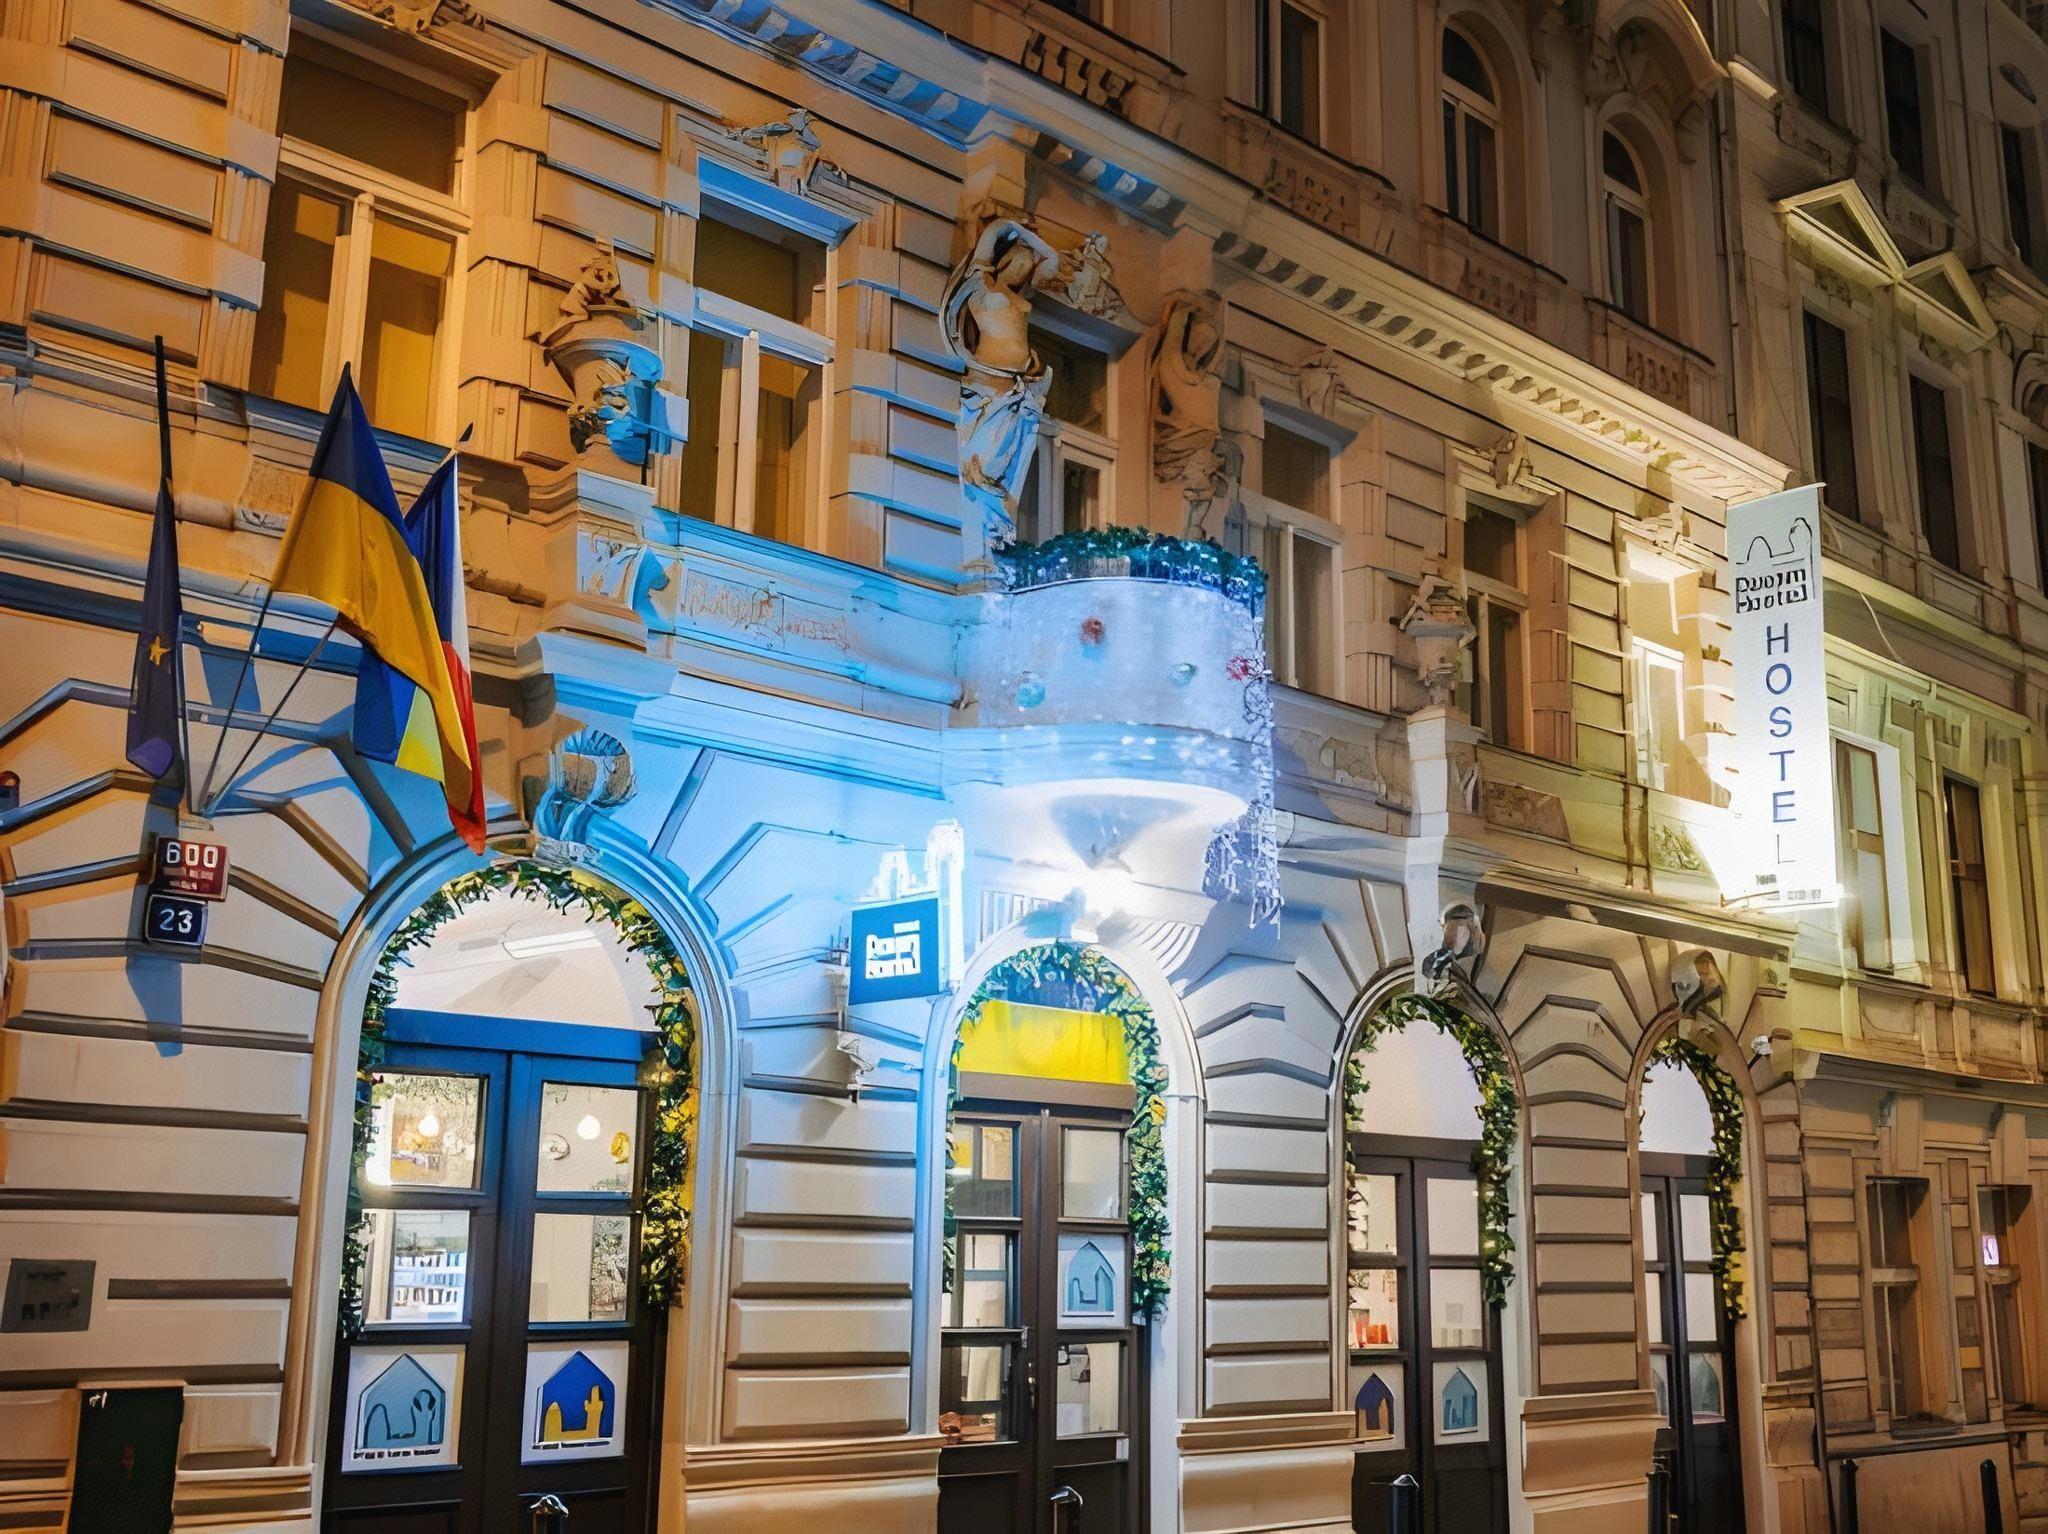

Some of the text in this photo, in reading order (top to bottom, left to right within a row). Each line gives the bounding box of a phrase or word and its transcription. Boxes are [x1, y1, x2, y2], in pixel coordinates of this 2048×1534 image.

[1765, 622, 1797, 865] HOSTEL
[166, 841, 219, 869] 600
[160, 908, 193, 934] 23
